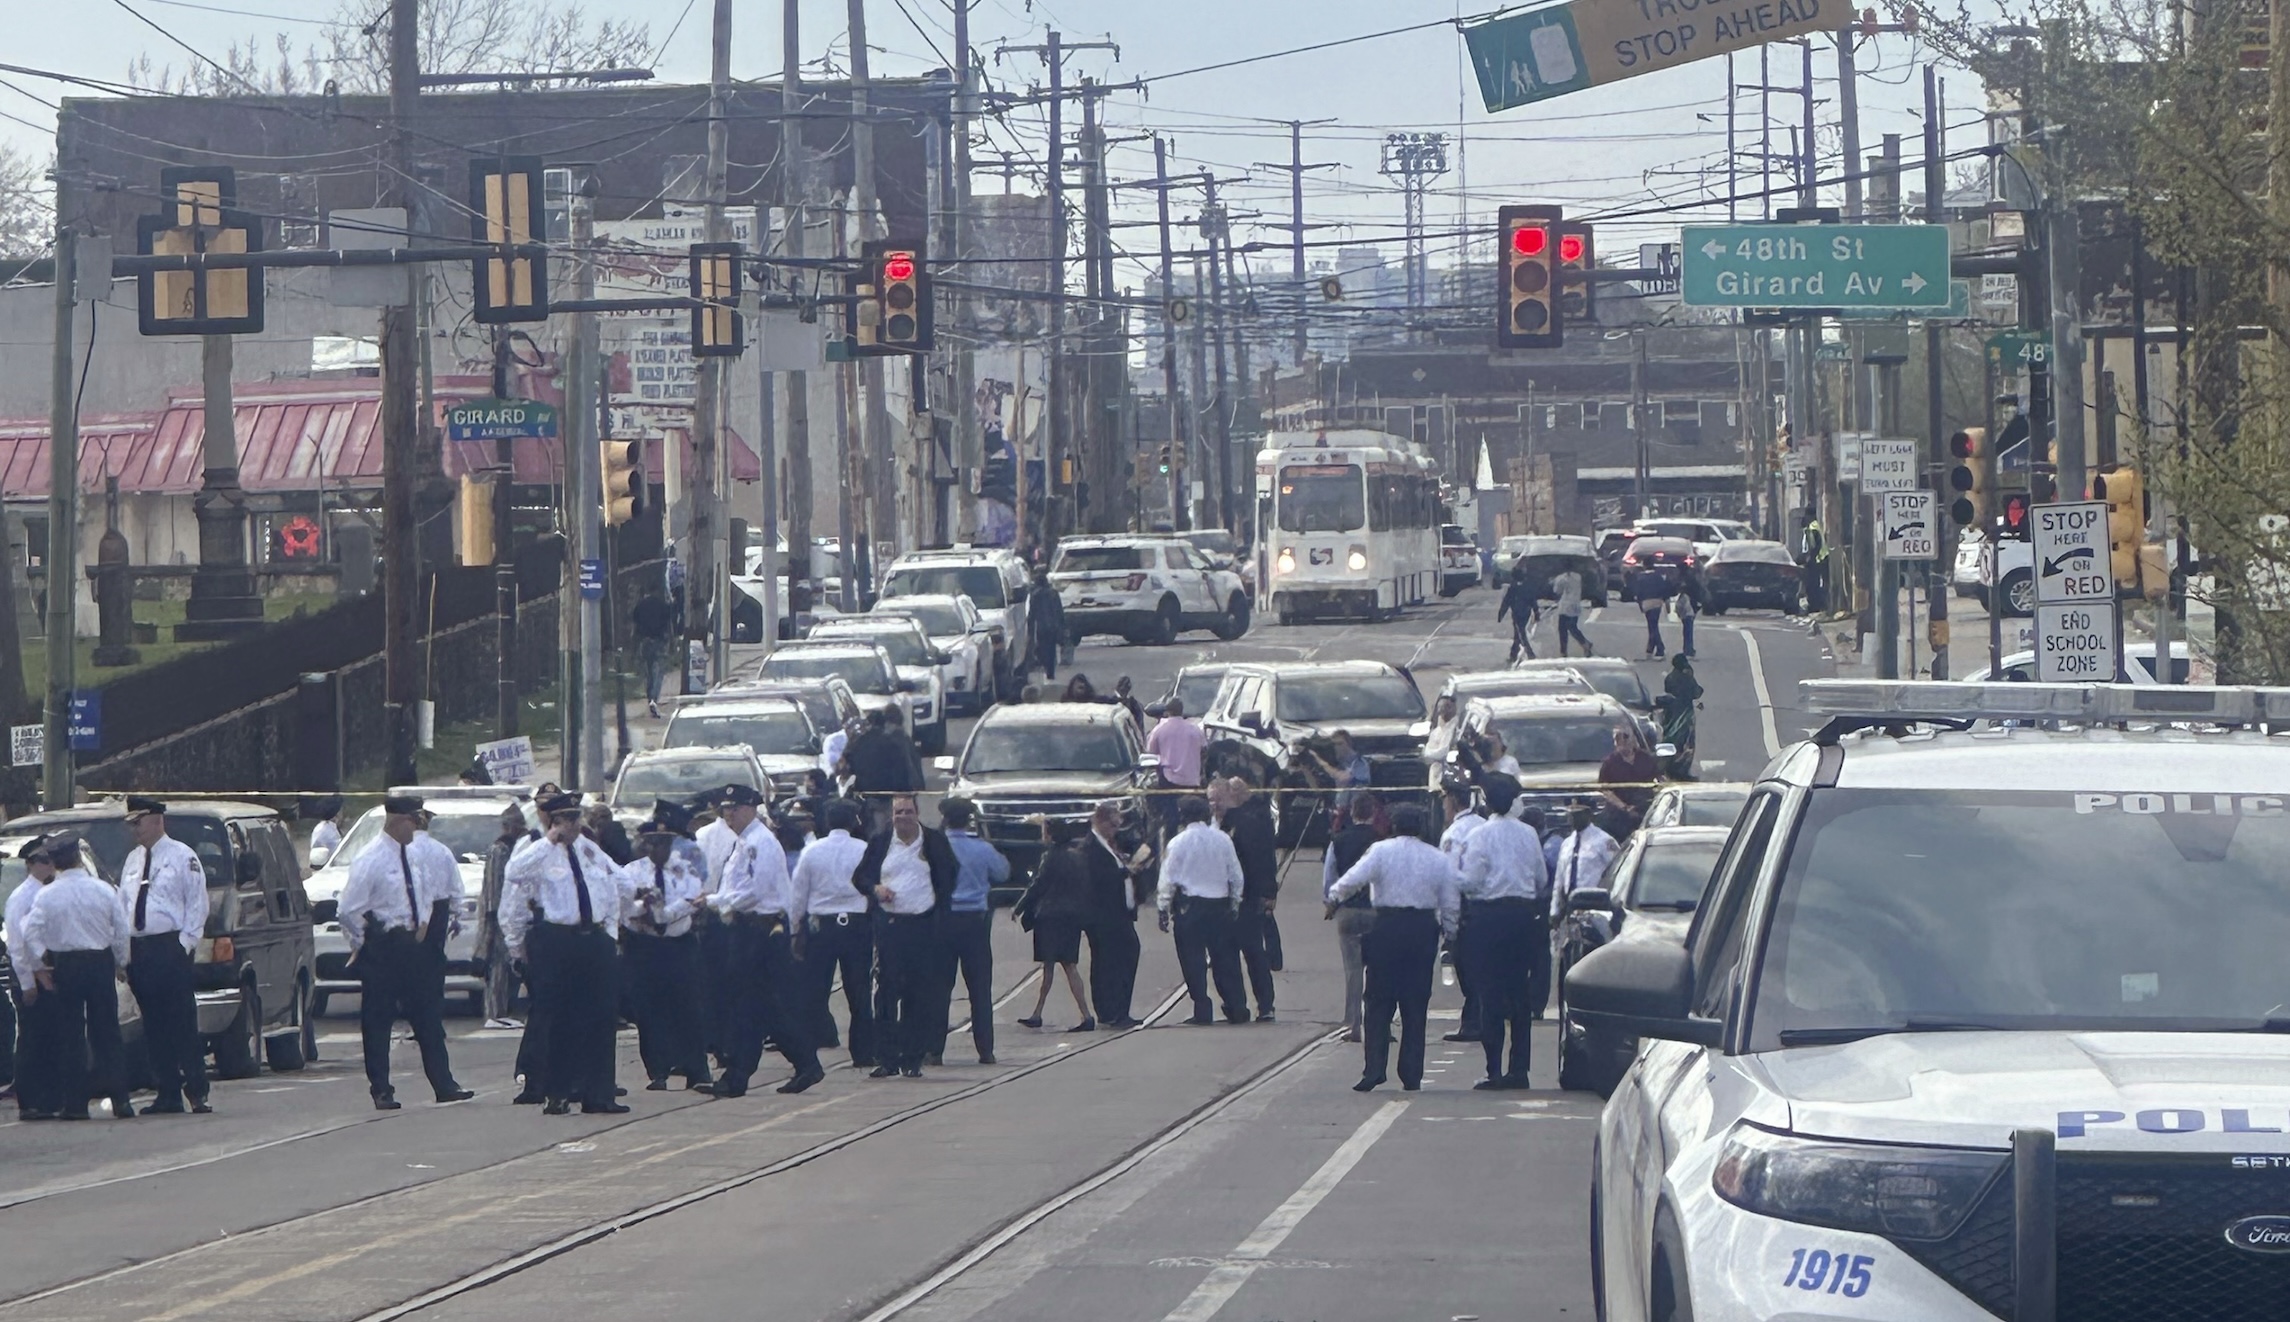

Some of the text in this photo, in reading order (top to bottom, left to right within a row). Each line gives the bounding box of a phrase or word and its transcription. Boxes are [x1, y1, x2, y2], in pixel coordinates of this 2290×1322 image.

[1613, 0, 1821, 66] STOP AHEAD
[1735, 235, 1865, 261] 48th St
[1716, 271, 1884, 296] Girard Av
[2018, 342, 2044, 362] 48
[453, 408, 526, 425] GIRARD
[1889, 495, 1929, 509] STOP
[2041, 510, 2098, 531] STOP
[2053, 531, 2089, 546] HERE
[2064, 575, 2106, 596] RED
[2061, 611, 2091, 630] END
[2045, 634, 2107, 651] SCHOOL
[2056, 655, 2097, 673] ZONE
[2057, 1108, 2290, 1139] POL
[1783, 1248, 1876, 1298] 1915
